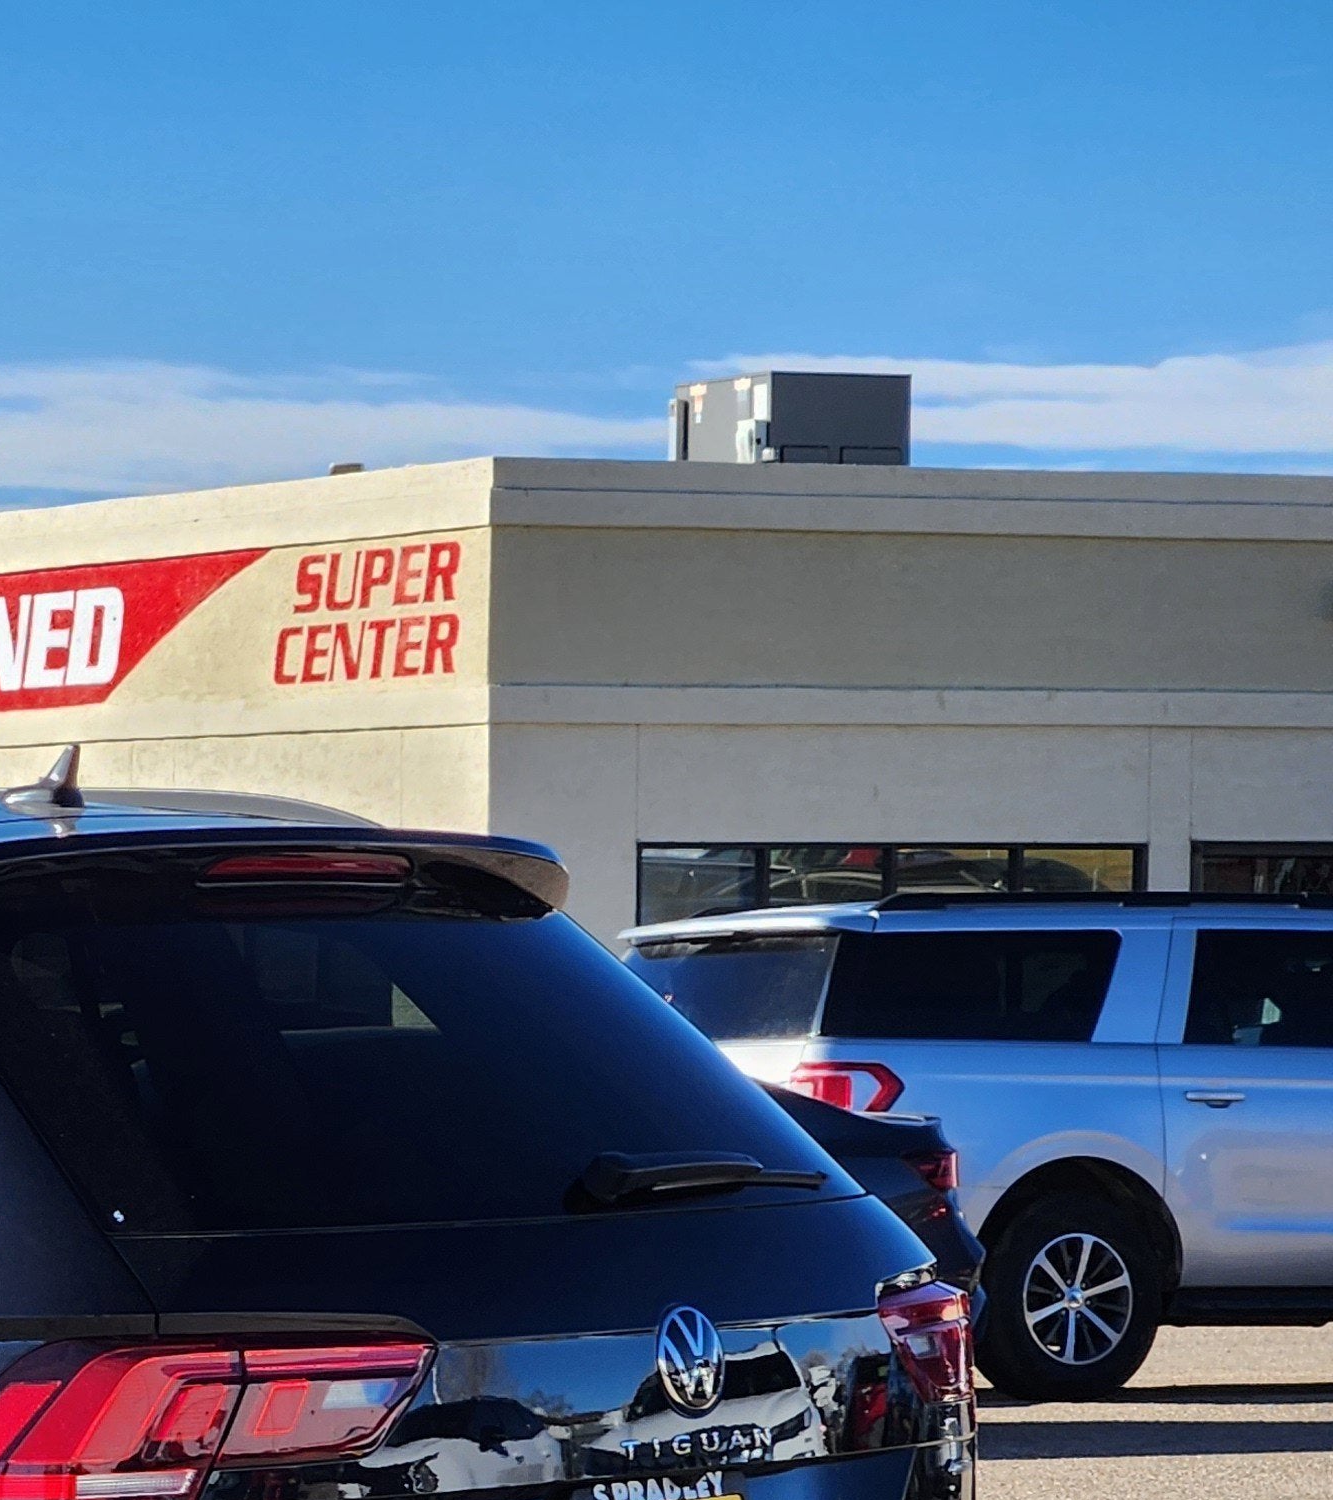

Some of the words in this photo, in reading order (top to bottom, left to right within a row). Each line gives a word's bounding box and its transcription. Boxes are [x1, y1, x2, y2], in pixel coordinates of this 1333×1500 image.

[295, 541, 459, 613] SUPER
[273, 613, 458, 685] CENTER
[620, 1427, 772, 1460] TIGUAN
